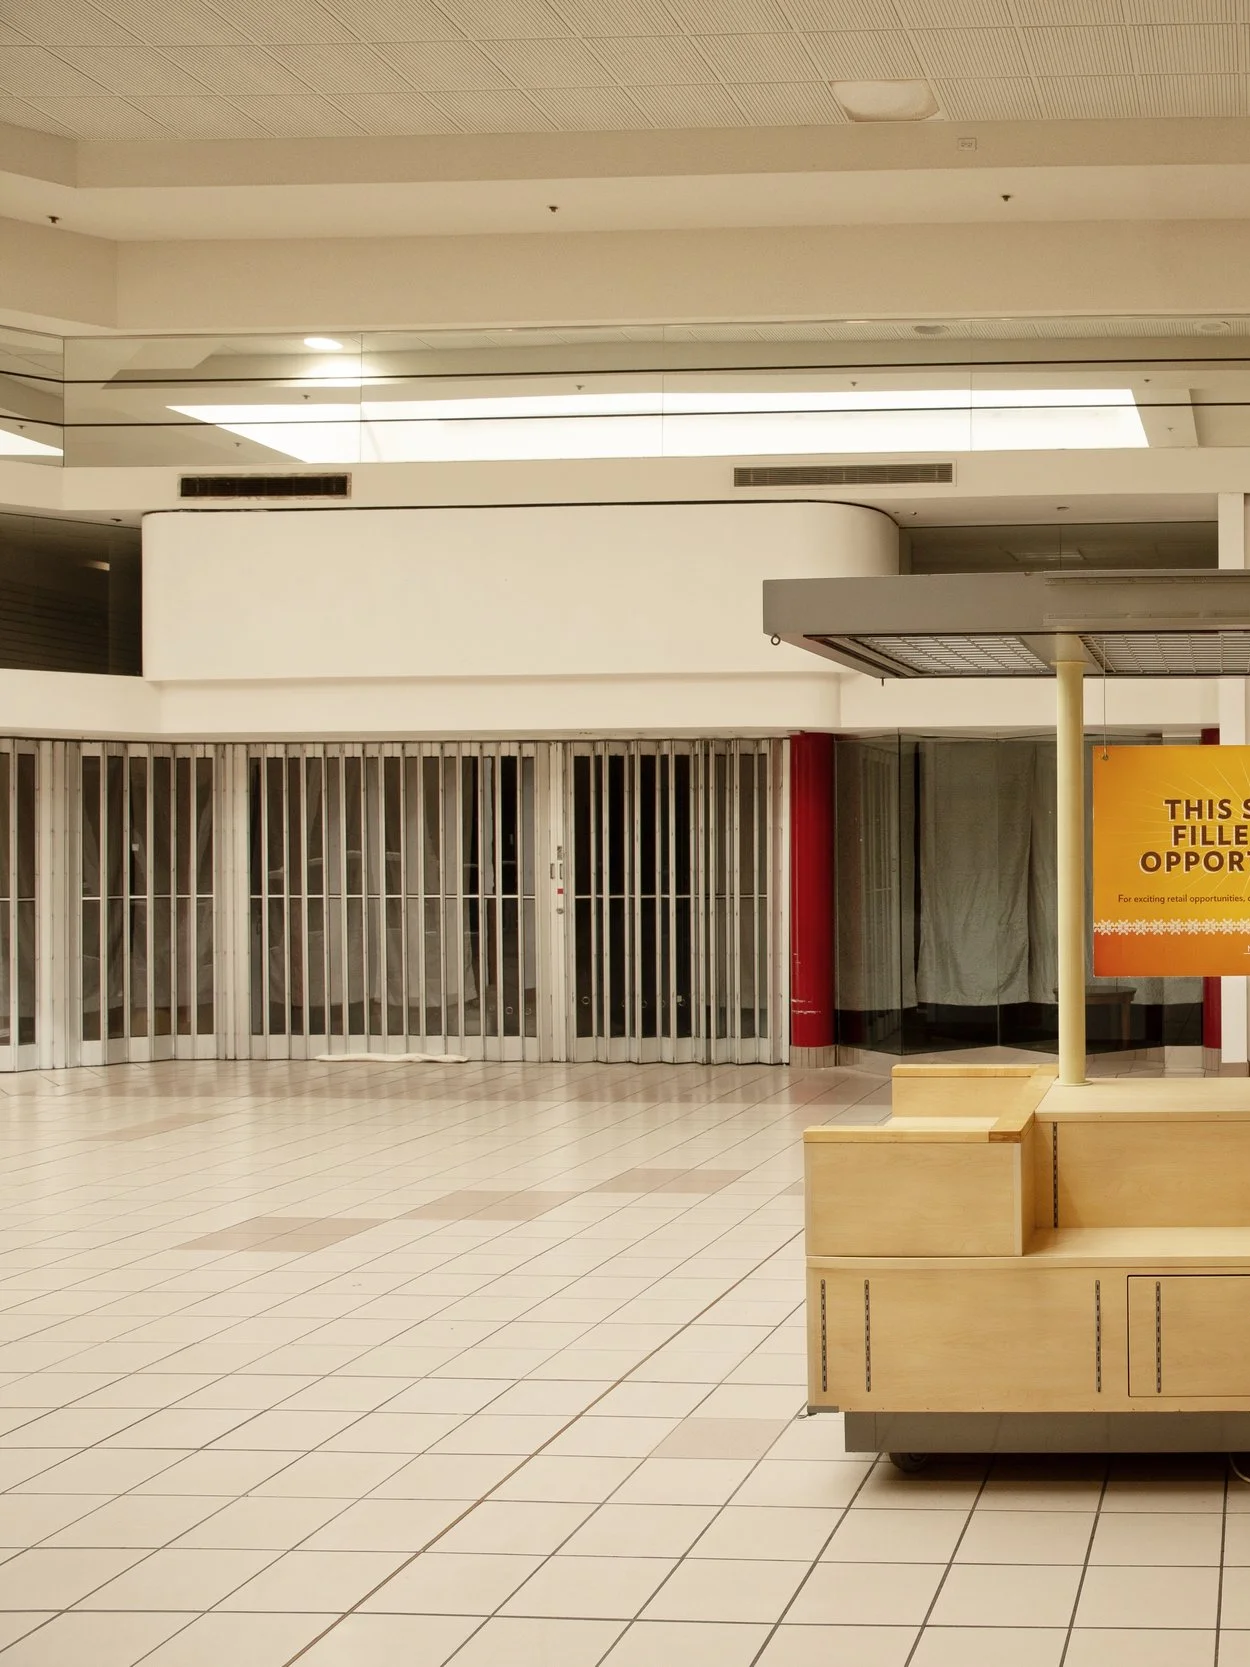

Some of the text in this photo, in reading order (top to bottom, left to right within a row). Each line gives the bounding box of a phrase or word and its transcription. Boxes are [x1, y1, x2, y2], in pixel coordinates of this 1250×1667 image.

[1164, 799, 1232, 821] THIS
[1118, 894, 1132, 903] For
[1134, 894, 1165, 904] exciting
[1167, 894, 1187, 903] retail
[1189, 894, 1246, 904] opportunities,
